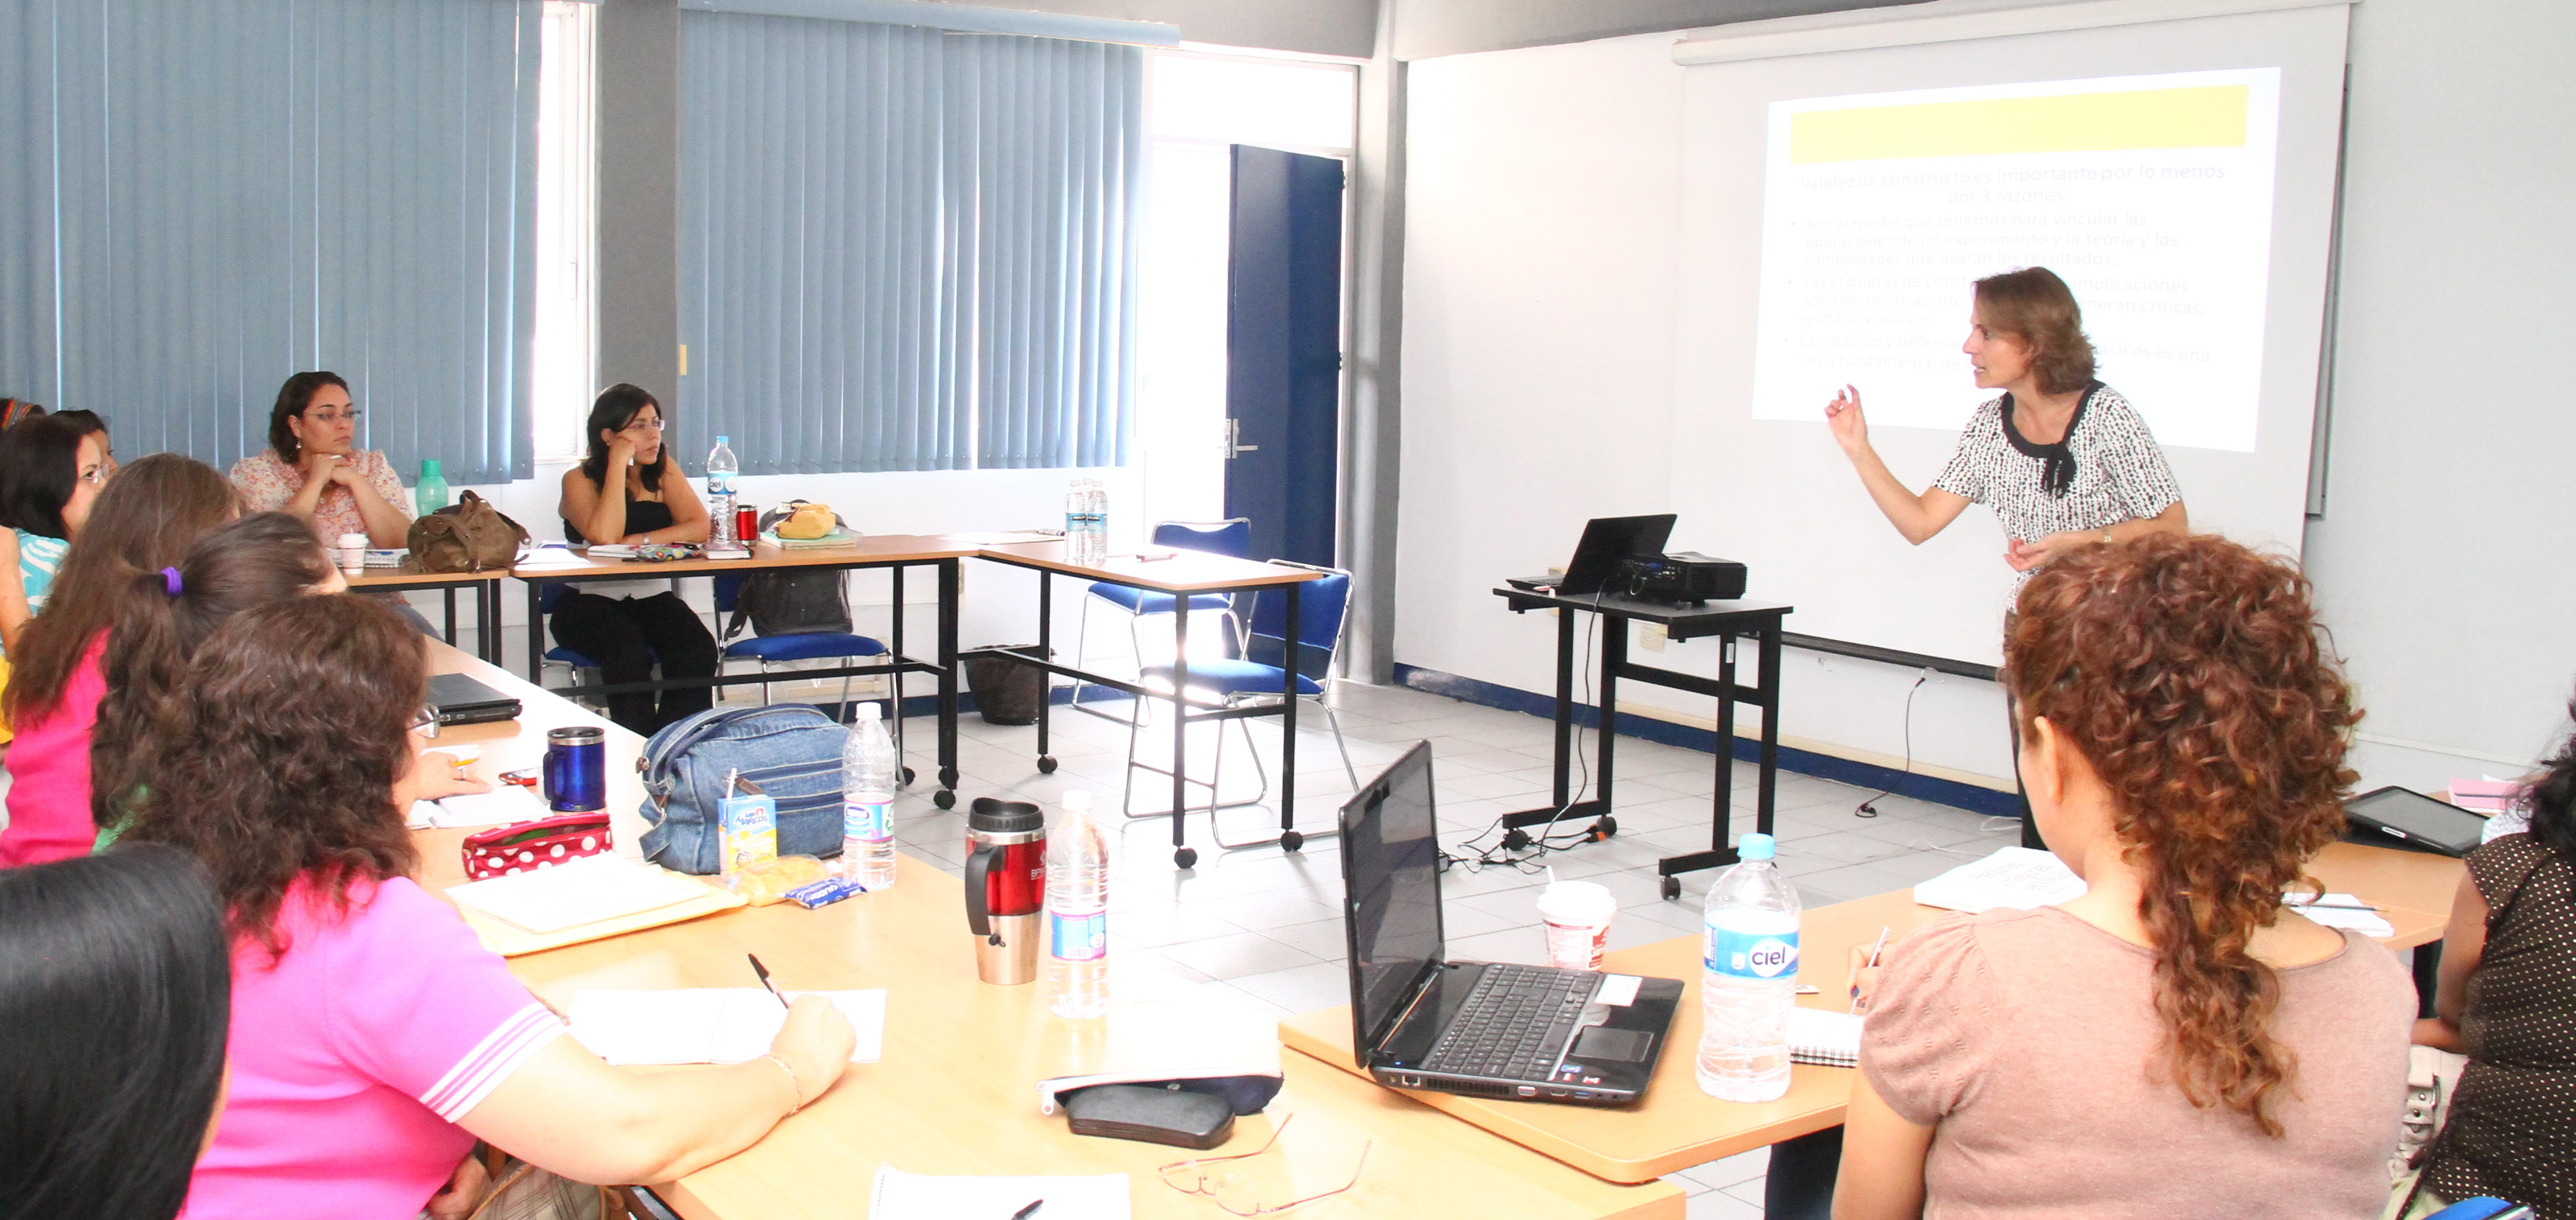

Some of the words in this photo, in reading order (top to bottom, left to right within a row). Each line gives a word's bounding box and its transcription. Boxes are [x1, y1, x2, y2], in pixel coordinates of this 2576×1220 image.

[1801, 175, 1855, 190] Validez
[1858, 174, 1877, 188] de
[1881, 171, 1970, 187] constructo
[1974, 171, 1992, 183] es
[1997, 167, 2098, 184] importante
[2101, 167, 2133, 183] por
[2140, 163, 2156, 179] lo
[2161, 166, 2225, 179] menos
[1947, 192, 1976, 205] por
[1981, 189, 1990, 203] 3
[1996, 189, 2069, 203] razones:
[1806, 218, 1831, 230] Son
[1835, 216, 1848, 230] el
[1853, 215, 1901, 229] medio
[1904, 217, 1933, 230] que
[1938, 215, 2007, 228] tenemos
[2012, 215, 2047, 228] para
[2053, 212, 2120, 226] vincular
[2124, 212, 2147, 226] las
[1806, 237, 1893, 249] operaciones
[1897, 234, 1916, 247] de
[1921, 236, 1940, 245] un
[1945, 234, 2048, 247] experimento
[2052, 235, 2061, 248] y
[2066, 232, 2080, 245] la
[2086, 232, 2135, 246] teoría
[2139, 237, 2149, 249] y
[2155, 233, 2178, 246] las
[1804, 251, 1902, 266] comunidades
[1905, 253, 1934, 267] que
[1997, 251, 2020, 265] los
[2025, 251, 2116, 267] resultados;
[1803, 276, 1826, 288] Las
[1830, 276, 1897, 291] etiquetas
[1901, 275, 1921, 288] de
[2073, 277, 2190, 293] implicaciones
[1802, 294, 1862, 307] sociales,
[2078, 299, 2135, 312] eneran
[1864, 315, 1873, 326] y
[1800, 335, 1815, 348] La
[1886, 338, 1893, 351] y
[1898, 336, 1959, 349] defensa
[2155, 348, 2174, 360] es
[2178, 348, 2210, 362] una
[1798, 355, 1835, 368] tarea
[1839, 353, 1937, 370] fundamental
[1941, 356, 1960, 371] de
[735, 815, 769, 826] MARCOS
[1751, 945, 1786, 967] ciel
